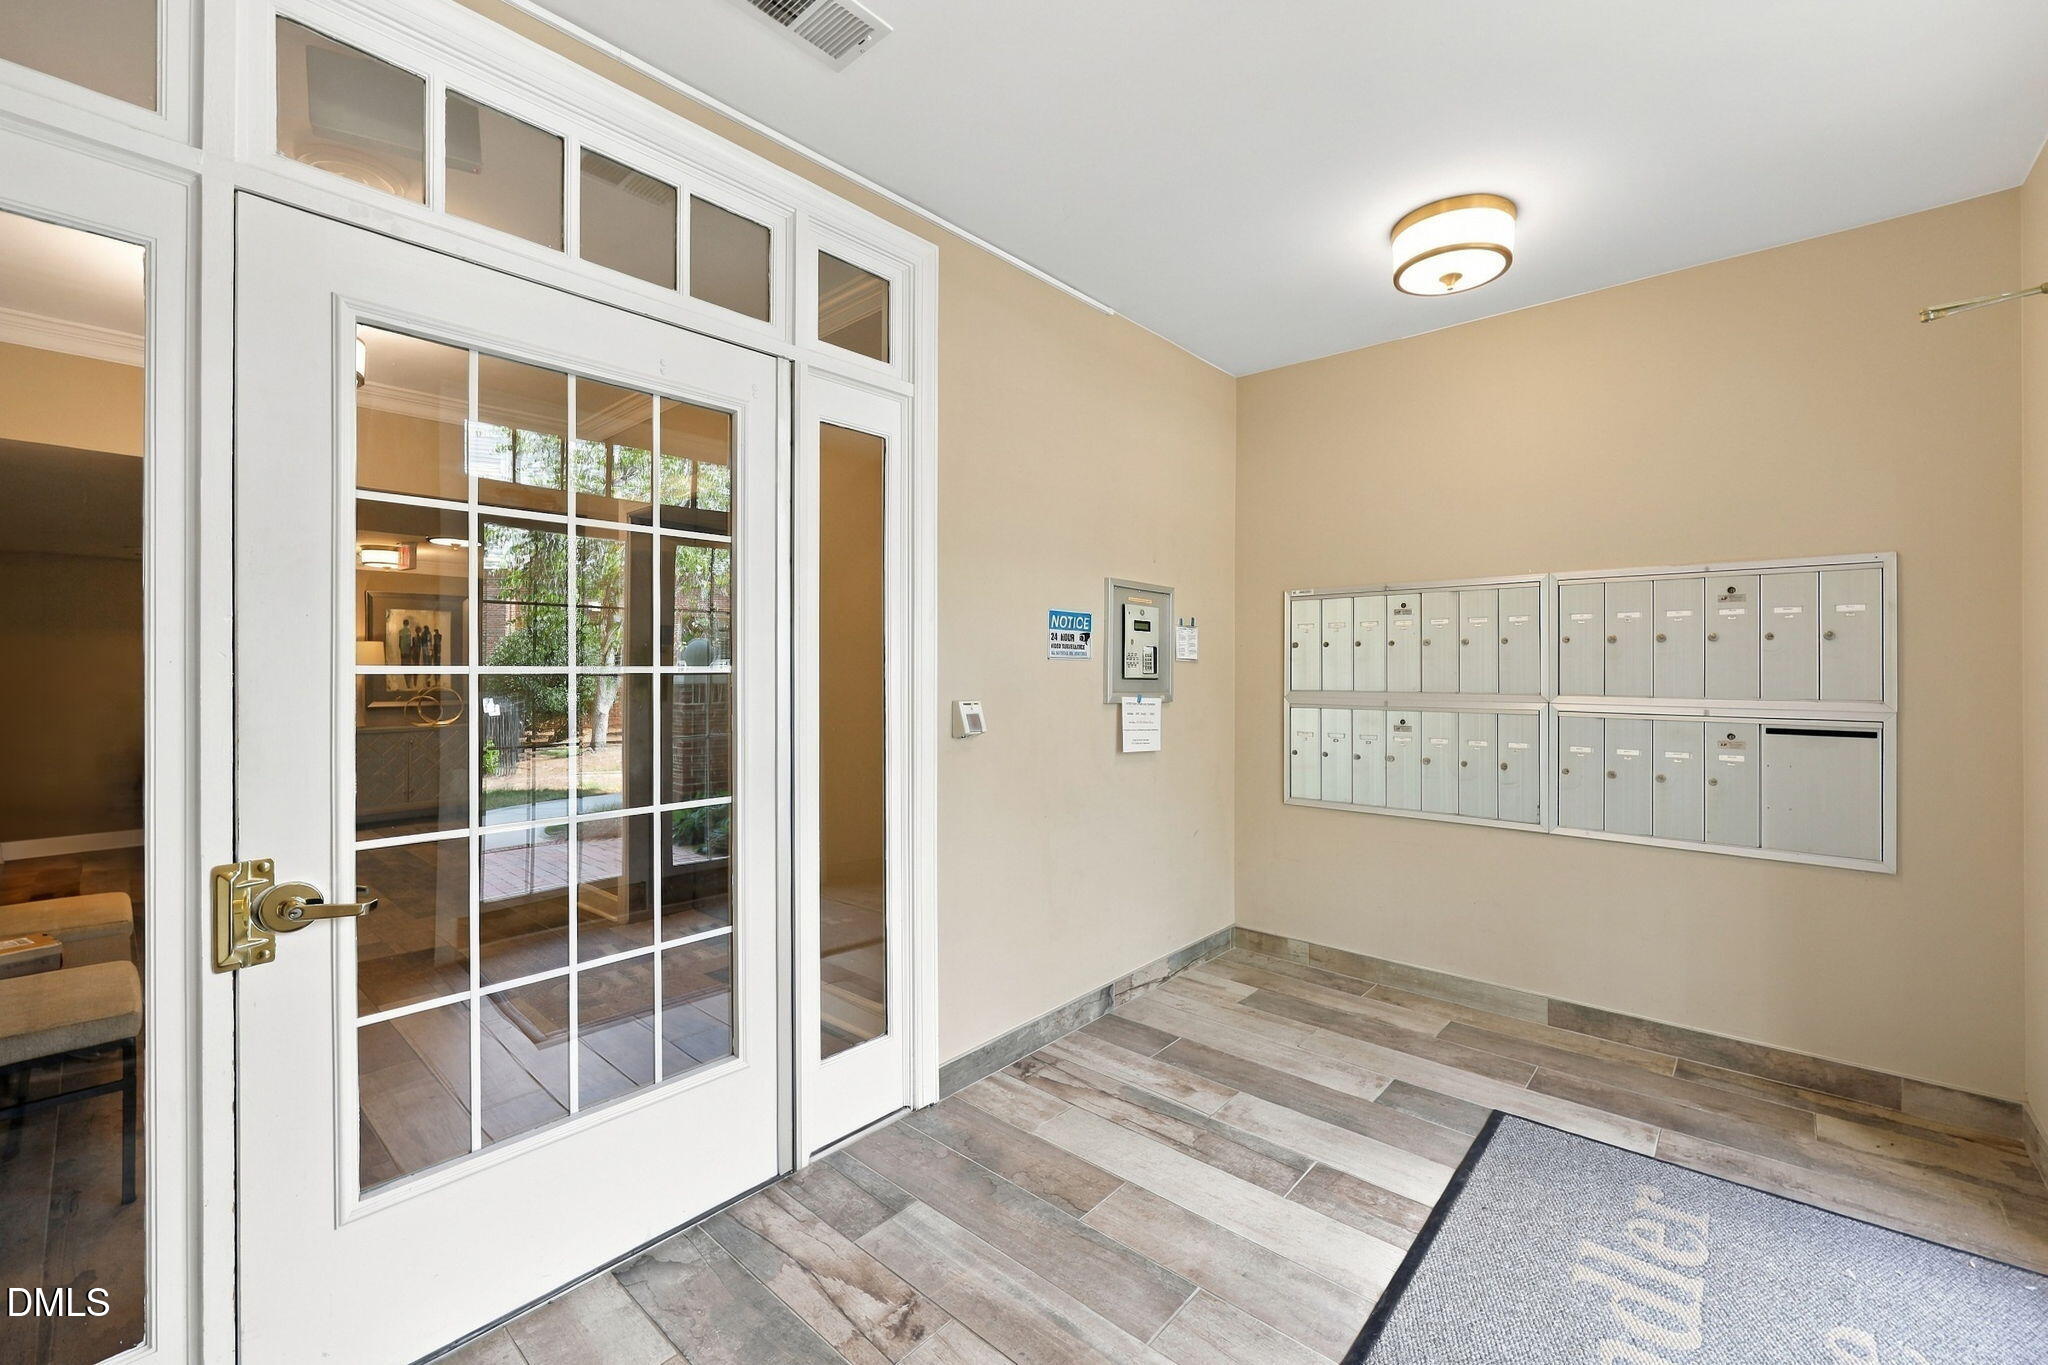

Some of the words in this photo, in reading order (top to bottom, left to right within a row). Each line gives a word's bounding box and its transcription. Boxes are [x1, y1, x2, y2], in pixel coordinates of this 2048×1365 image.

[1051, 614, 1090, 630] NOTICE
[1050, 632, 1058, 641] 24
[1060, 633, 1075, 642] HOUR
